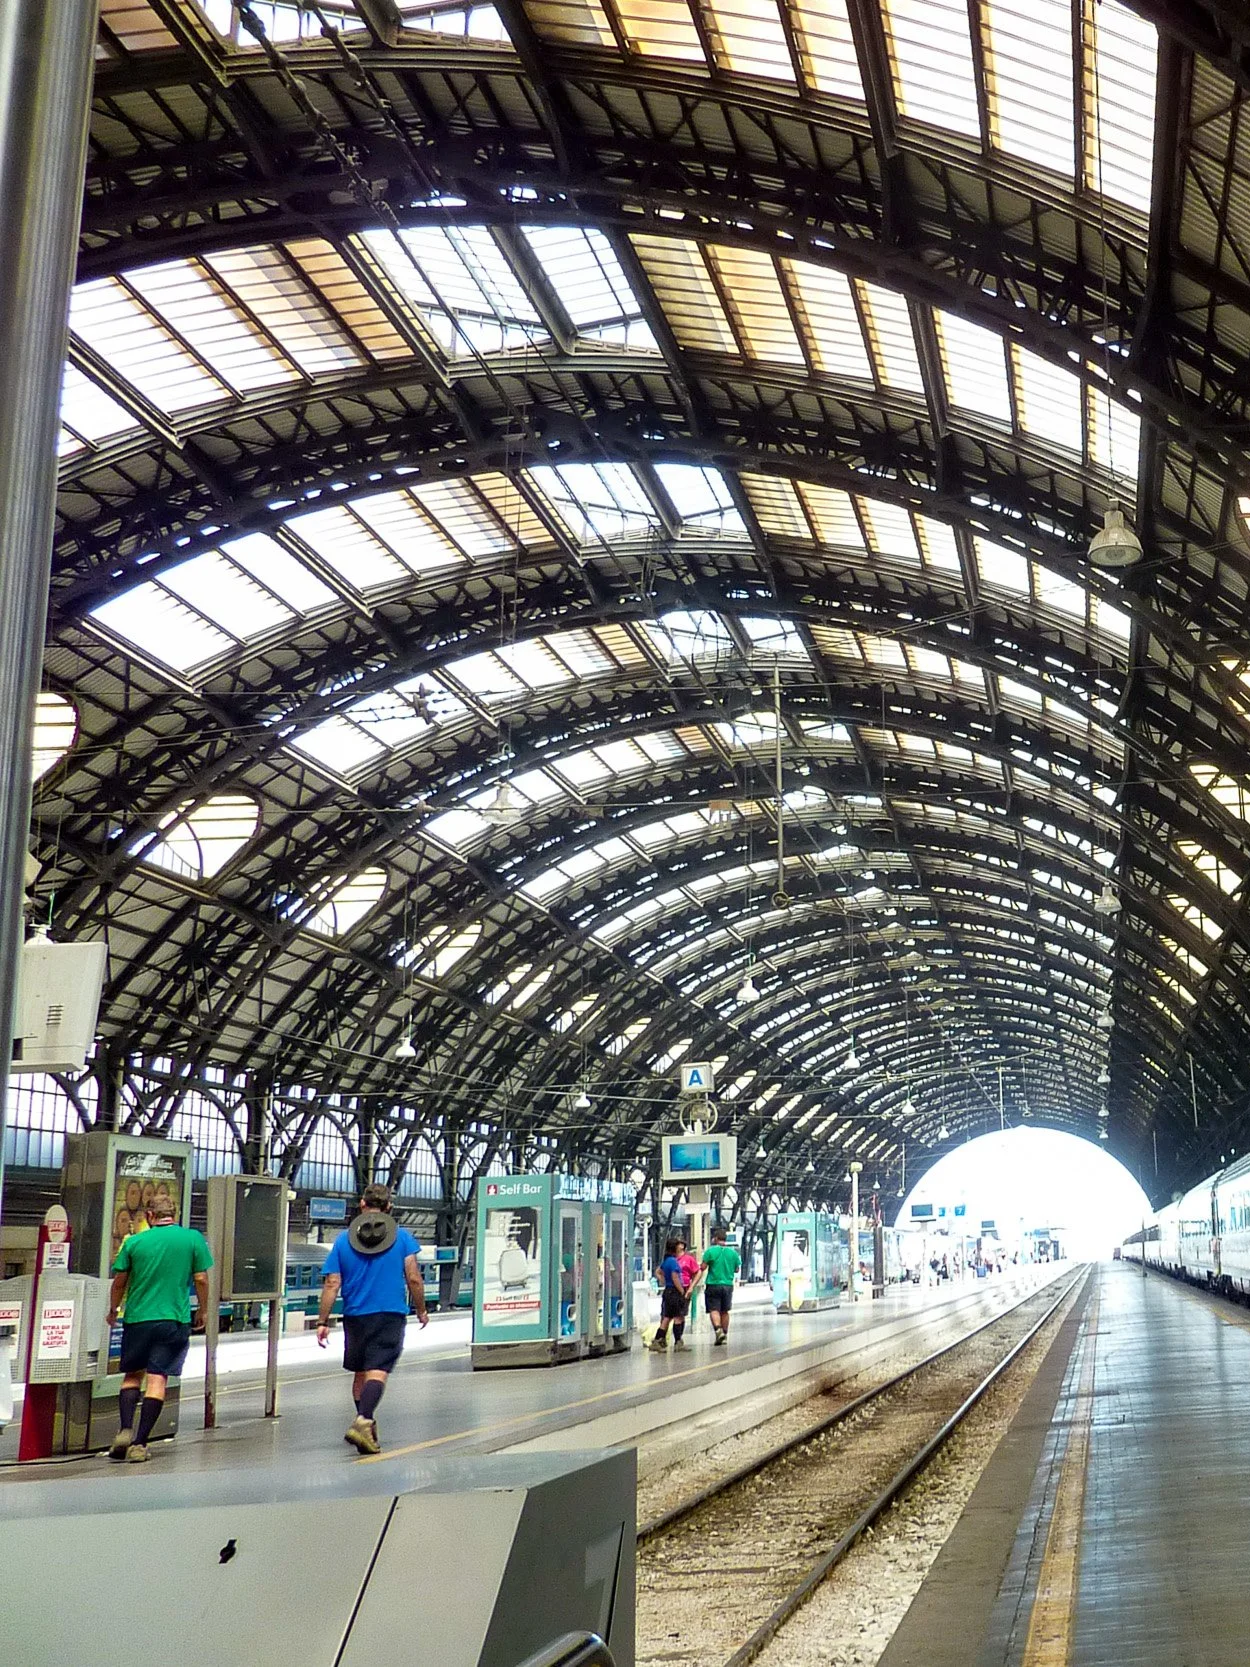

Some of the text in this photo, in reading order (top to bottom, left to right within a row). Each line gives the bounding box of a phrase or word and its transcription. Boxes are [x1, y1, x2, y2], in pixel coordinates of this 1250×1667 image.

[688, 1069, 703, 1086] A
[499, 1183, 542, 1195] Self Bar
